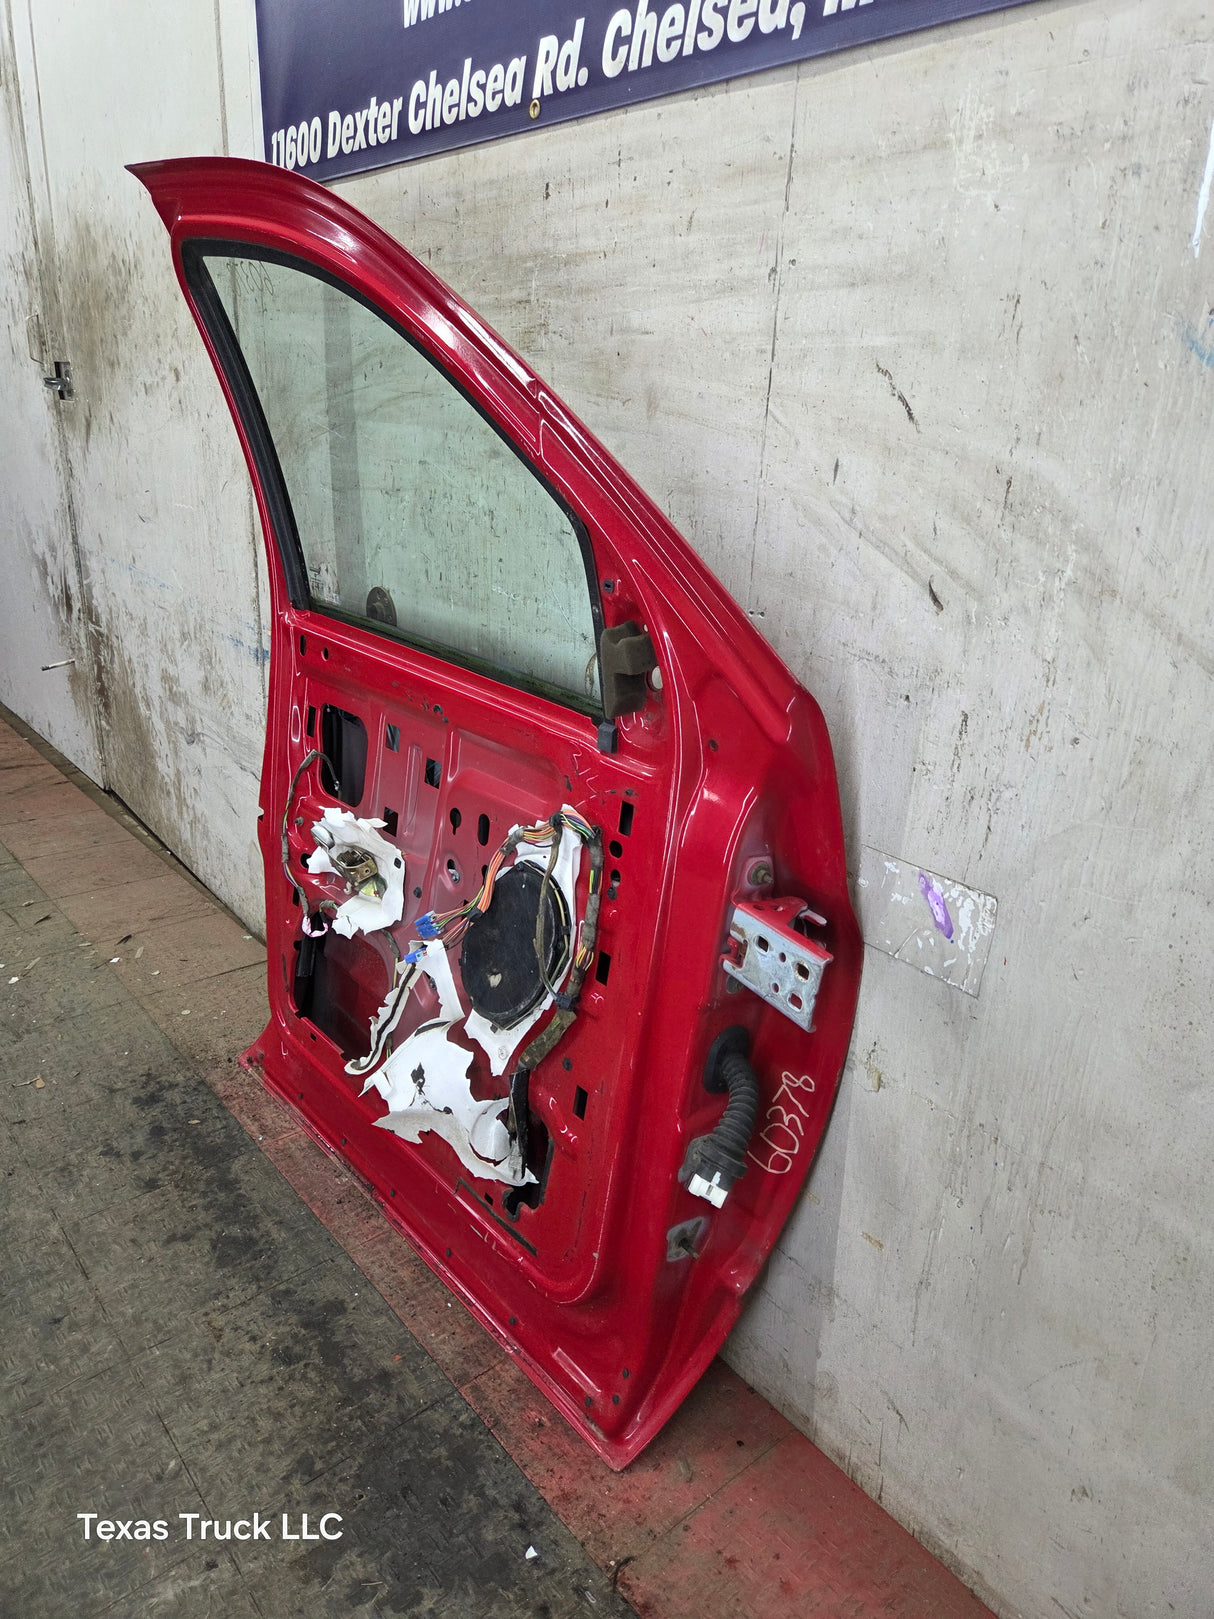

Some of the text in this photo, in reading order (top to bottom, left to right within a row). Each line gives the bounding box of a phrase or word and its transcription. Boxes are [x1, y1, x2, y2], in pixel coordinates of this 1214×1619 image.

[271, 116, 322, 171] 11600
[327, 96, 403, 159] Dexter
[408, 57, 527, 135] Chelsea
[532, 17, 589, 99] Rd.
[747, 1071, 815, 1174] 60378
